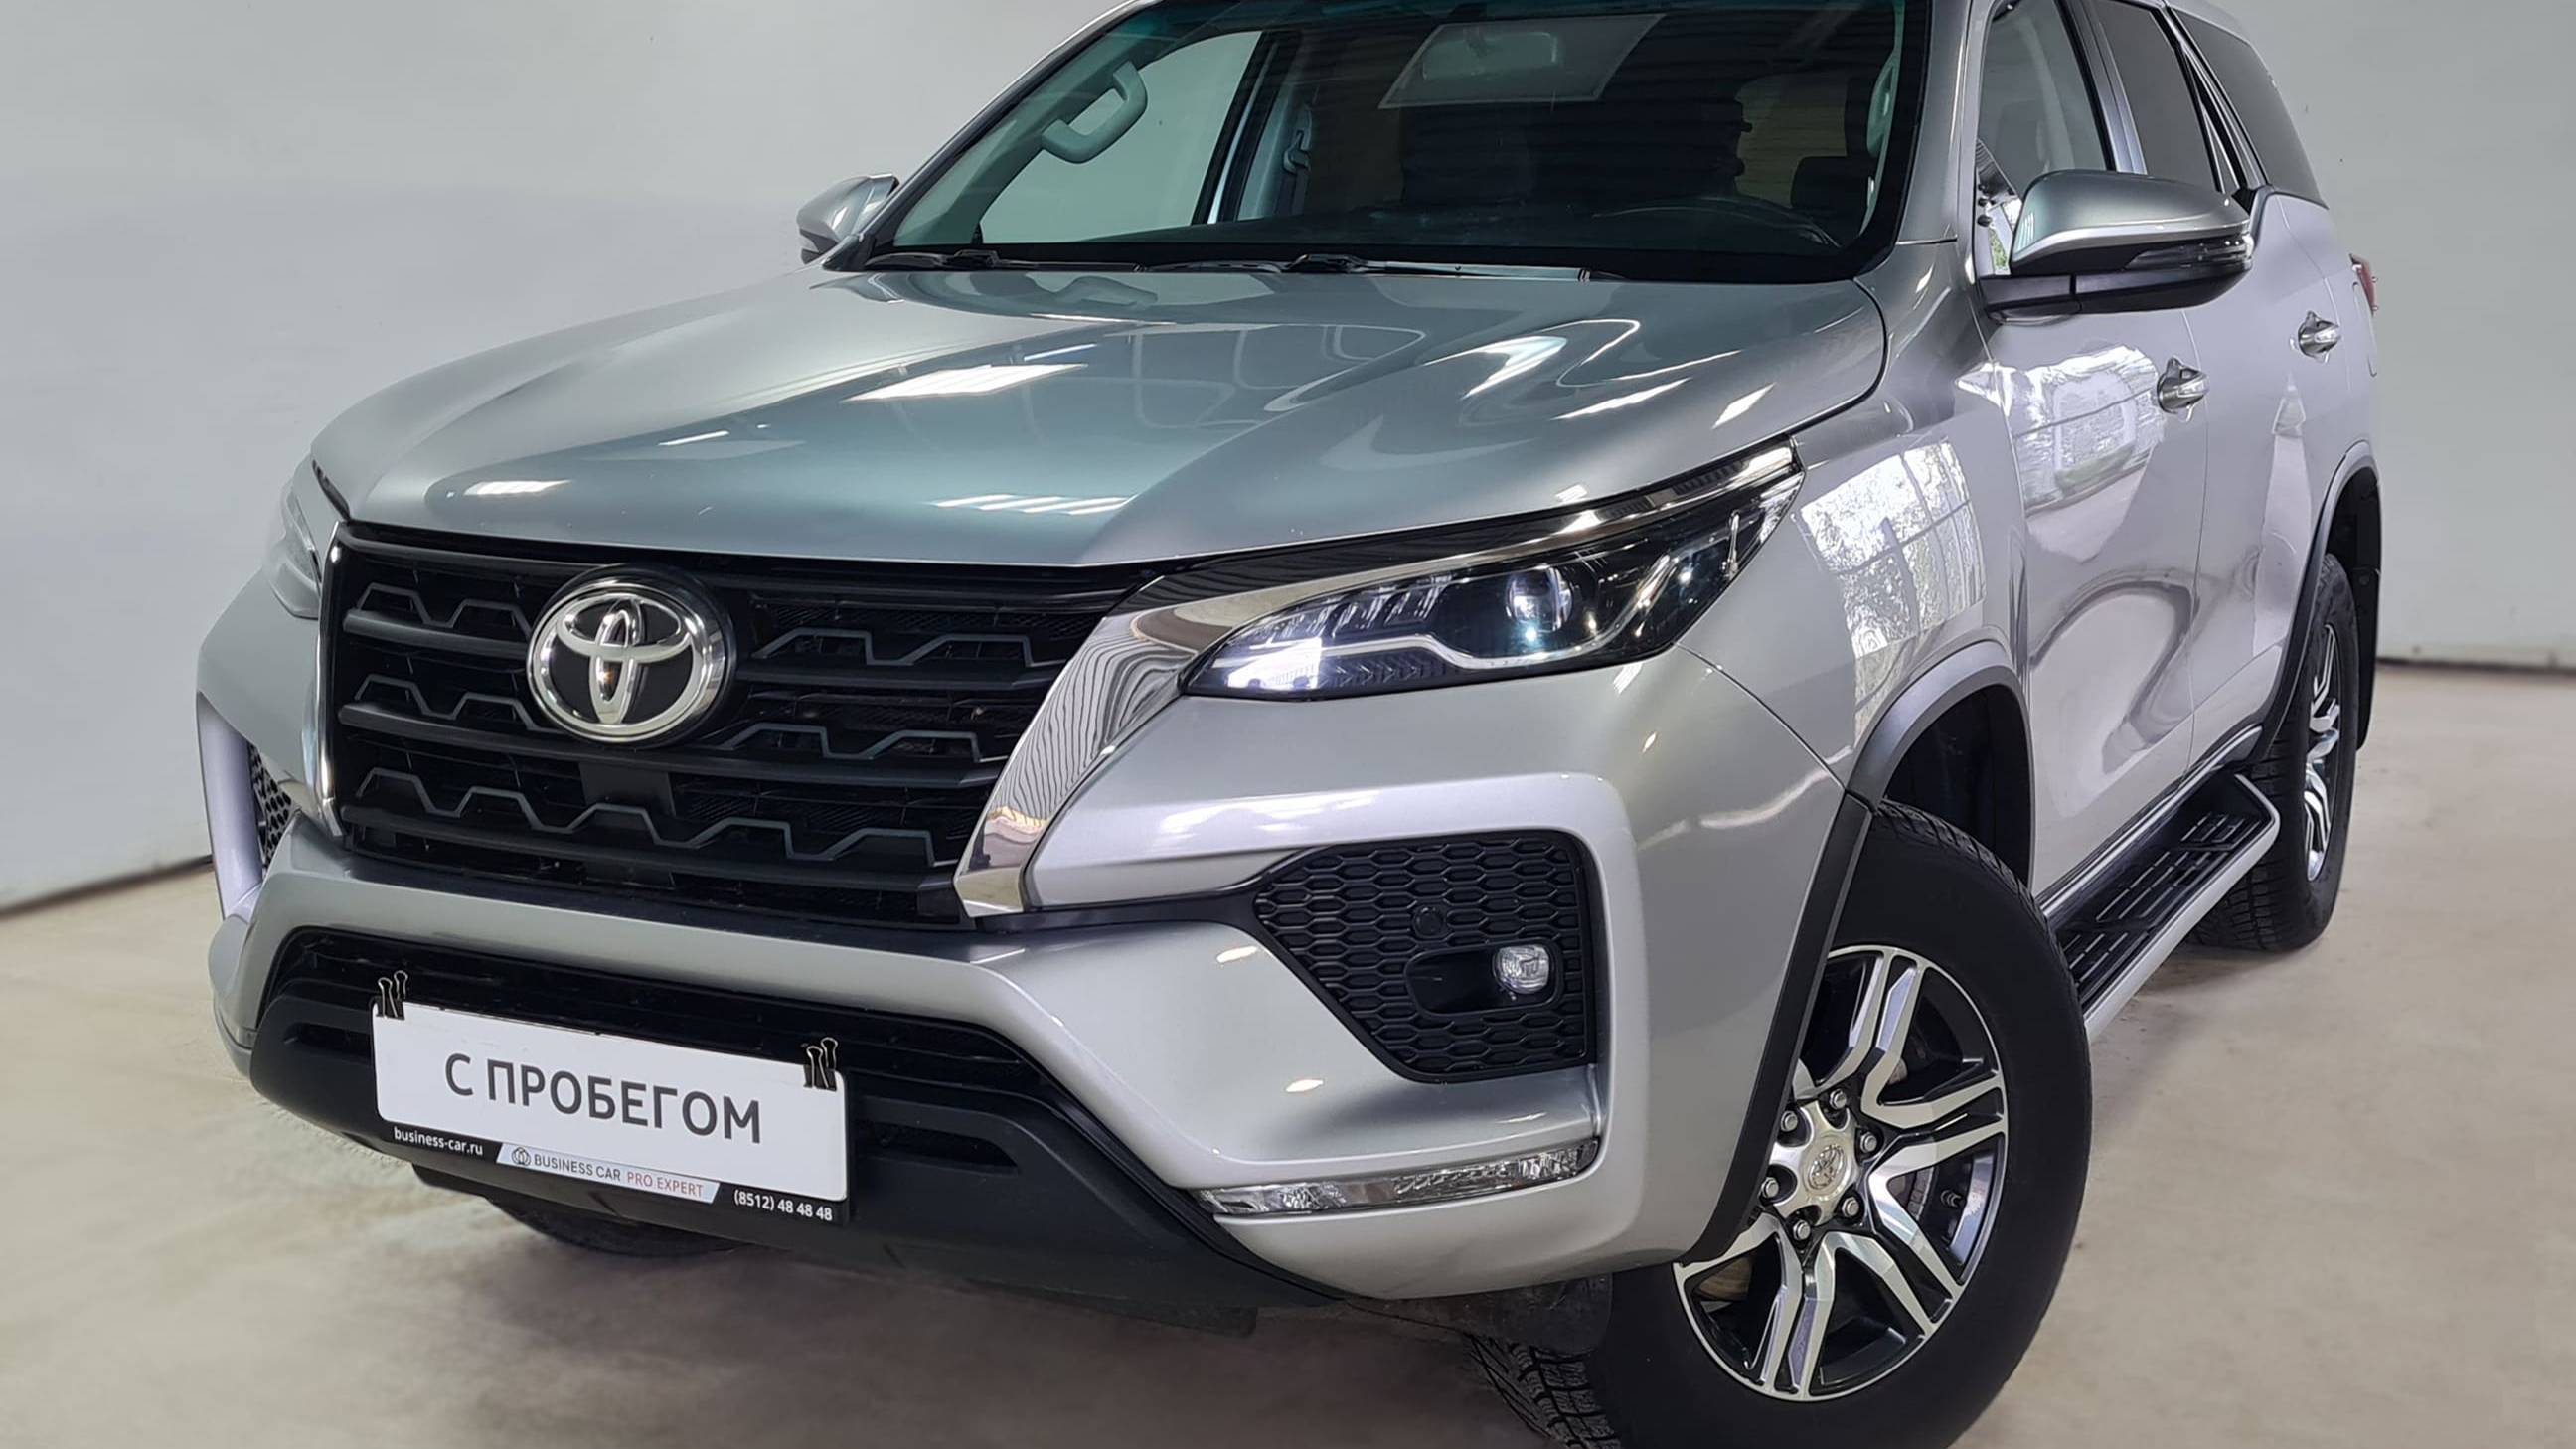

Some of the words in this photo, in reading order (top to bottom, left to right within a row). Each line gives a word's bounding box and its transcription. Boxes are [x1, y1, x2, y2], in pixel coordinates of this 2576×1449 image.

[444, 1052, 472, 1096] С
[486, 1059, 761, 1144] ПРОБЕГОМ
[393, 1126, 483, 1156] business-car.ru
[534, 1153, 593, 1176] BUSINESS
[596, 1165, 621, 1181] CAR
[627, 1171, 653, 1187] PRO
[657, 1177, 704, 1197] EXPERT
[734, 1189, 775, 1211] (8512)
[777, 1199, 793, 1213] 48
[796, 1203, 813, 1217] 48
[816, 1206, 833, 1221] 48
